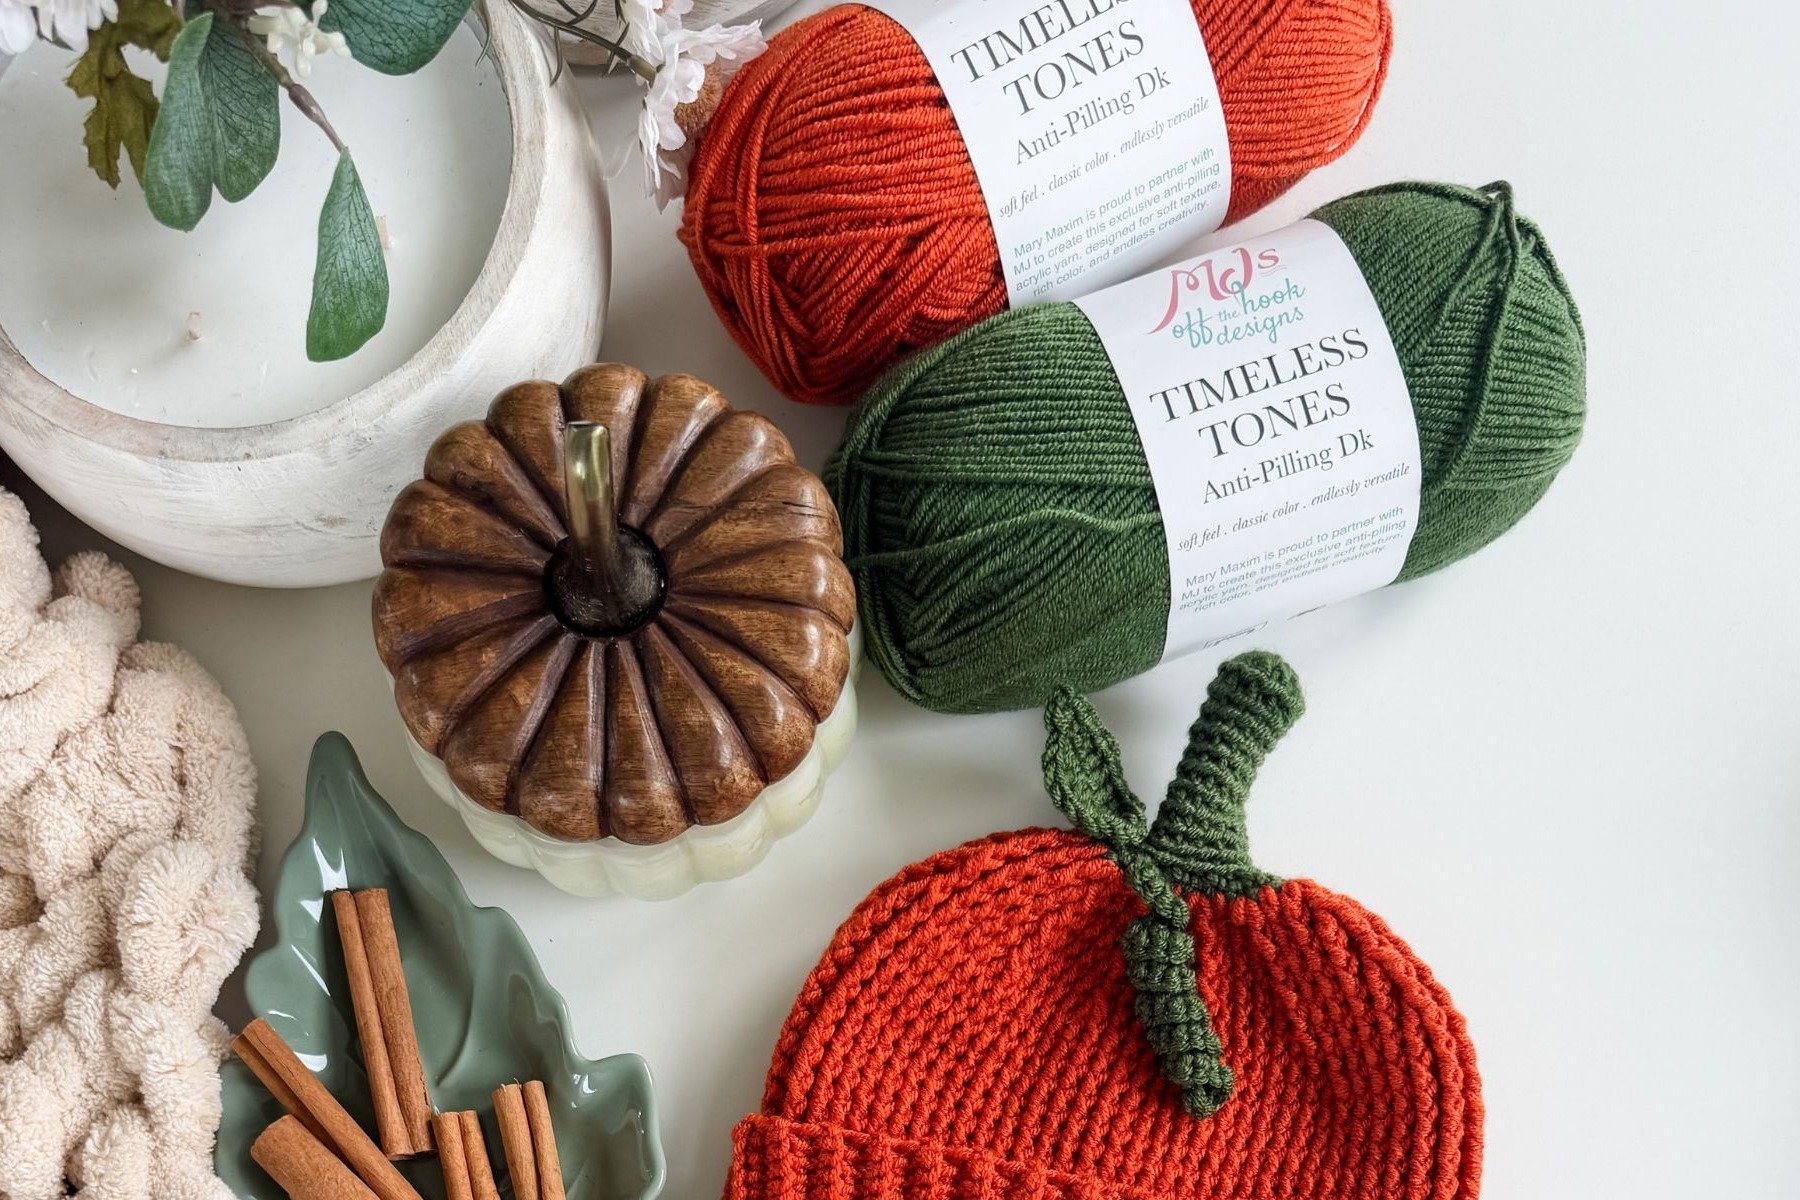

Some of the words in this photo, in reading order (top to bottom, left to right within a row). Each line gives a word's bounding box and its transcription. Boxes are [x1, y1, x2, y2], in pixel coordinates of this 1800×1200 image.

[1002, 19, 1144, 116] TONES
[999, 195, 1017, 218] soft
[1019, 185, 1038, 212] feel
[1049, 164, 1082, 191] classic
[1085, 151, 1110, 172] color
[1120, 120, 1165, 154] endlessly
[1168, 96, 1209, 129] versatile
[1016, 90, 1135, 165] Anti-Pilling
[1134, 66, 1172, 99] Dk
[1013, 259, 1031, 276] MJ
[1033, 254, 1045, 265] to
[1047, 233, 1082, 258] create
[1085, 222, 1106, 238] this
[1109, 194, 1160, 226] exclusive
[1164, 163, 1220, 198] anti-pilling
[1014, 237, 1042, 258] Mary
[1045, 216, 1084, 242] Maxim
[1086, 208, 1096, 221] is
[1099, 189, 1132, 217] proud
[1134, 184, 1145, 197] to
[1148, 161, 1188, 191] partner
[1191, 147, 1214, 166] with
[1016, 267, 1052, 292] acrylic
[1085, 221, 1136, 255] designed
[1139, 213, 1154, 227] for
[1157, 200, 1177, 218] soft
[1033, 281, 1053, 297] rich
[1089, 250, 1110, 268] and
[1113, 227, 1155, 255] endless
[1172, 307, 1213, 348] off
[1217, 309, 1240, 322] the
[1231, 278, 1306, 314] hook
[1217, 307, 1304, 344] designs
[1149, 328, 1369, 423] TIMELESS
[1198, 383, 1351, 458] TONES
[1178, 532, 1198, 552] soft
[1198, 524, 1221, 547] feel
[1232, 510, 1269, 532] classic
[1272, 501, 1300, 519] color
[1311, 480, 1361, 506] endlessly
[1364, 462, 1410, 488] versatile
[1203, 448, 1334, 504] Anti-Pilling
[1338, 429, 1375, 458] Dk
[1181, 588, 1200, 601] MJ
[1203, 584, 1215, 594] to
[1219, 571, 1257, 589] create
[1260, 561, 1282, 575] this
[1285, 542, 1341, 566] exclusive
[1186, 571, 1217, 587] Mary
[1220, 556, 1261, 576] Maxim
[1264, 551, 1275, 561] is
[1278, 536, 1313, 559] proud
[1317, 533, 1329, 543] to
[1332, 516, 1375, 540] partner
[1379, 506, 1403, 521] with
